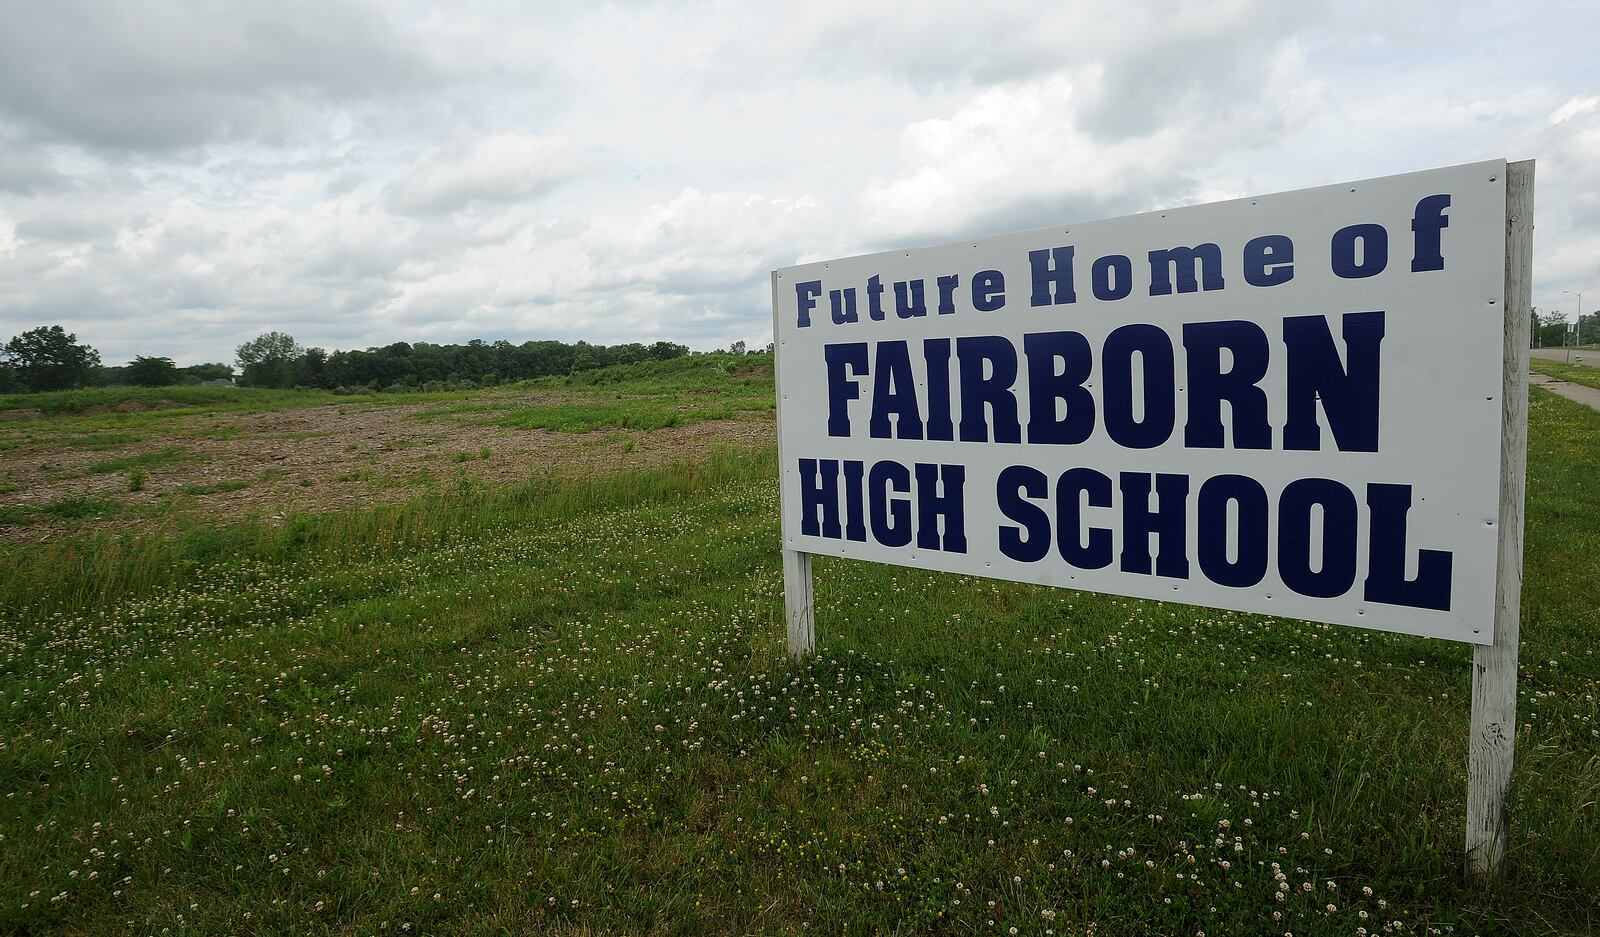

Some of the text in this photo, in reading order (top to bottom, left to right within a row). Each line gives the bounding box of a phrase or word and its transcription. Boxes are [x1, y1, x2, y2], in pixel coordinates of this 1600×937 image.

[795, 194, 1452, 328] Future Home of
[824, 311, 1386, 452] FAIRBORN
[798, 458, 1453, 612] HIGH SCHOOL
